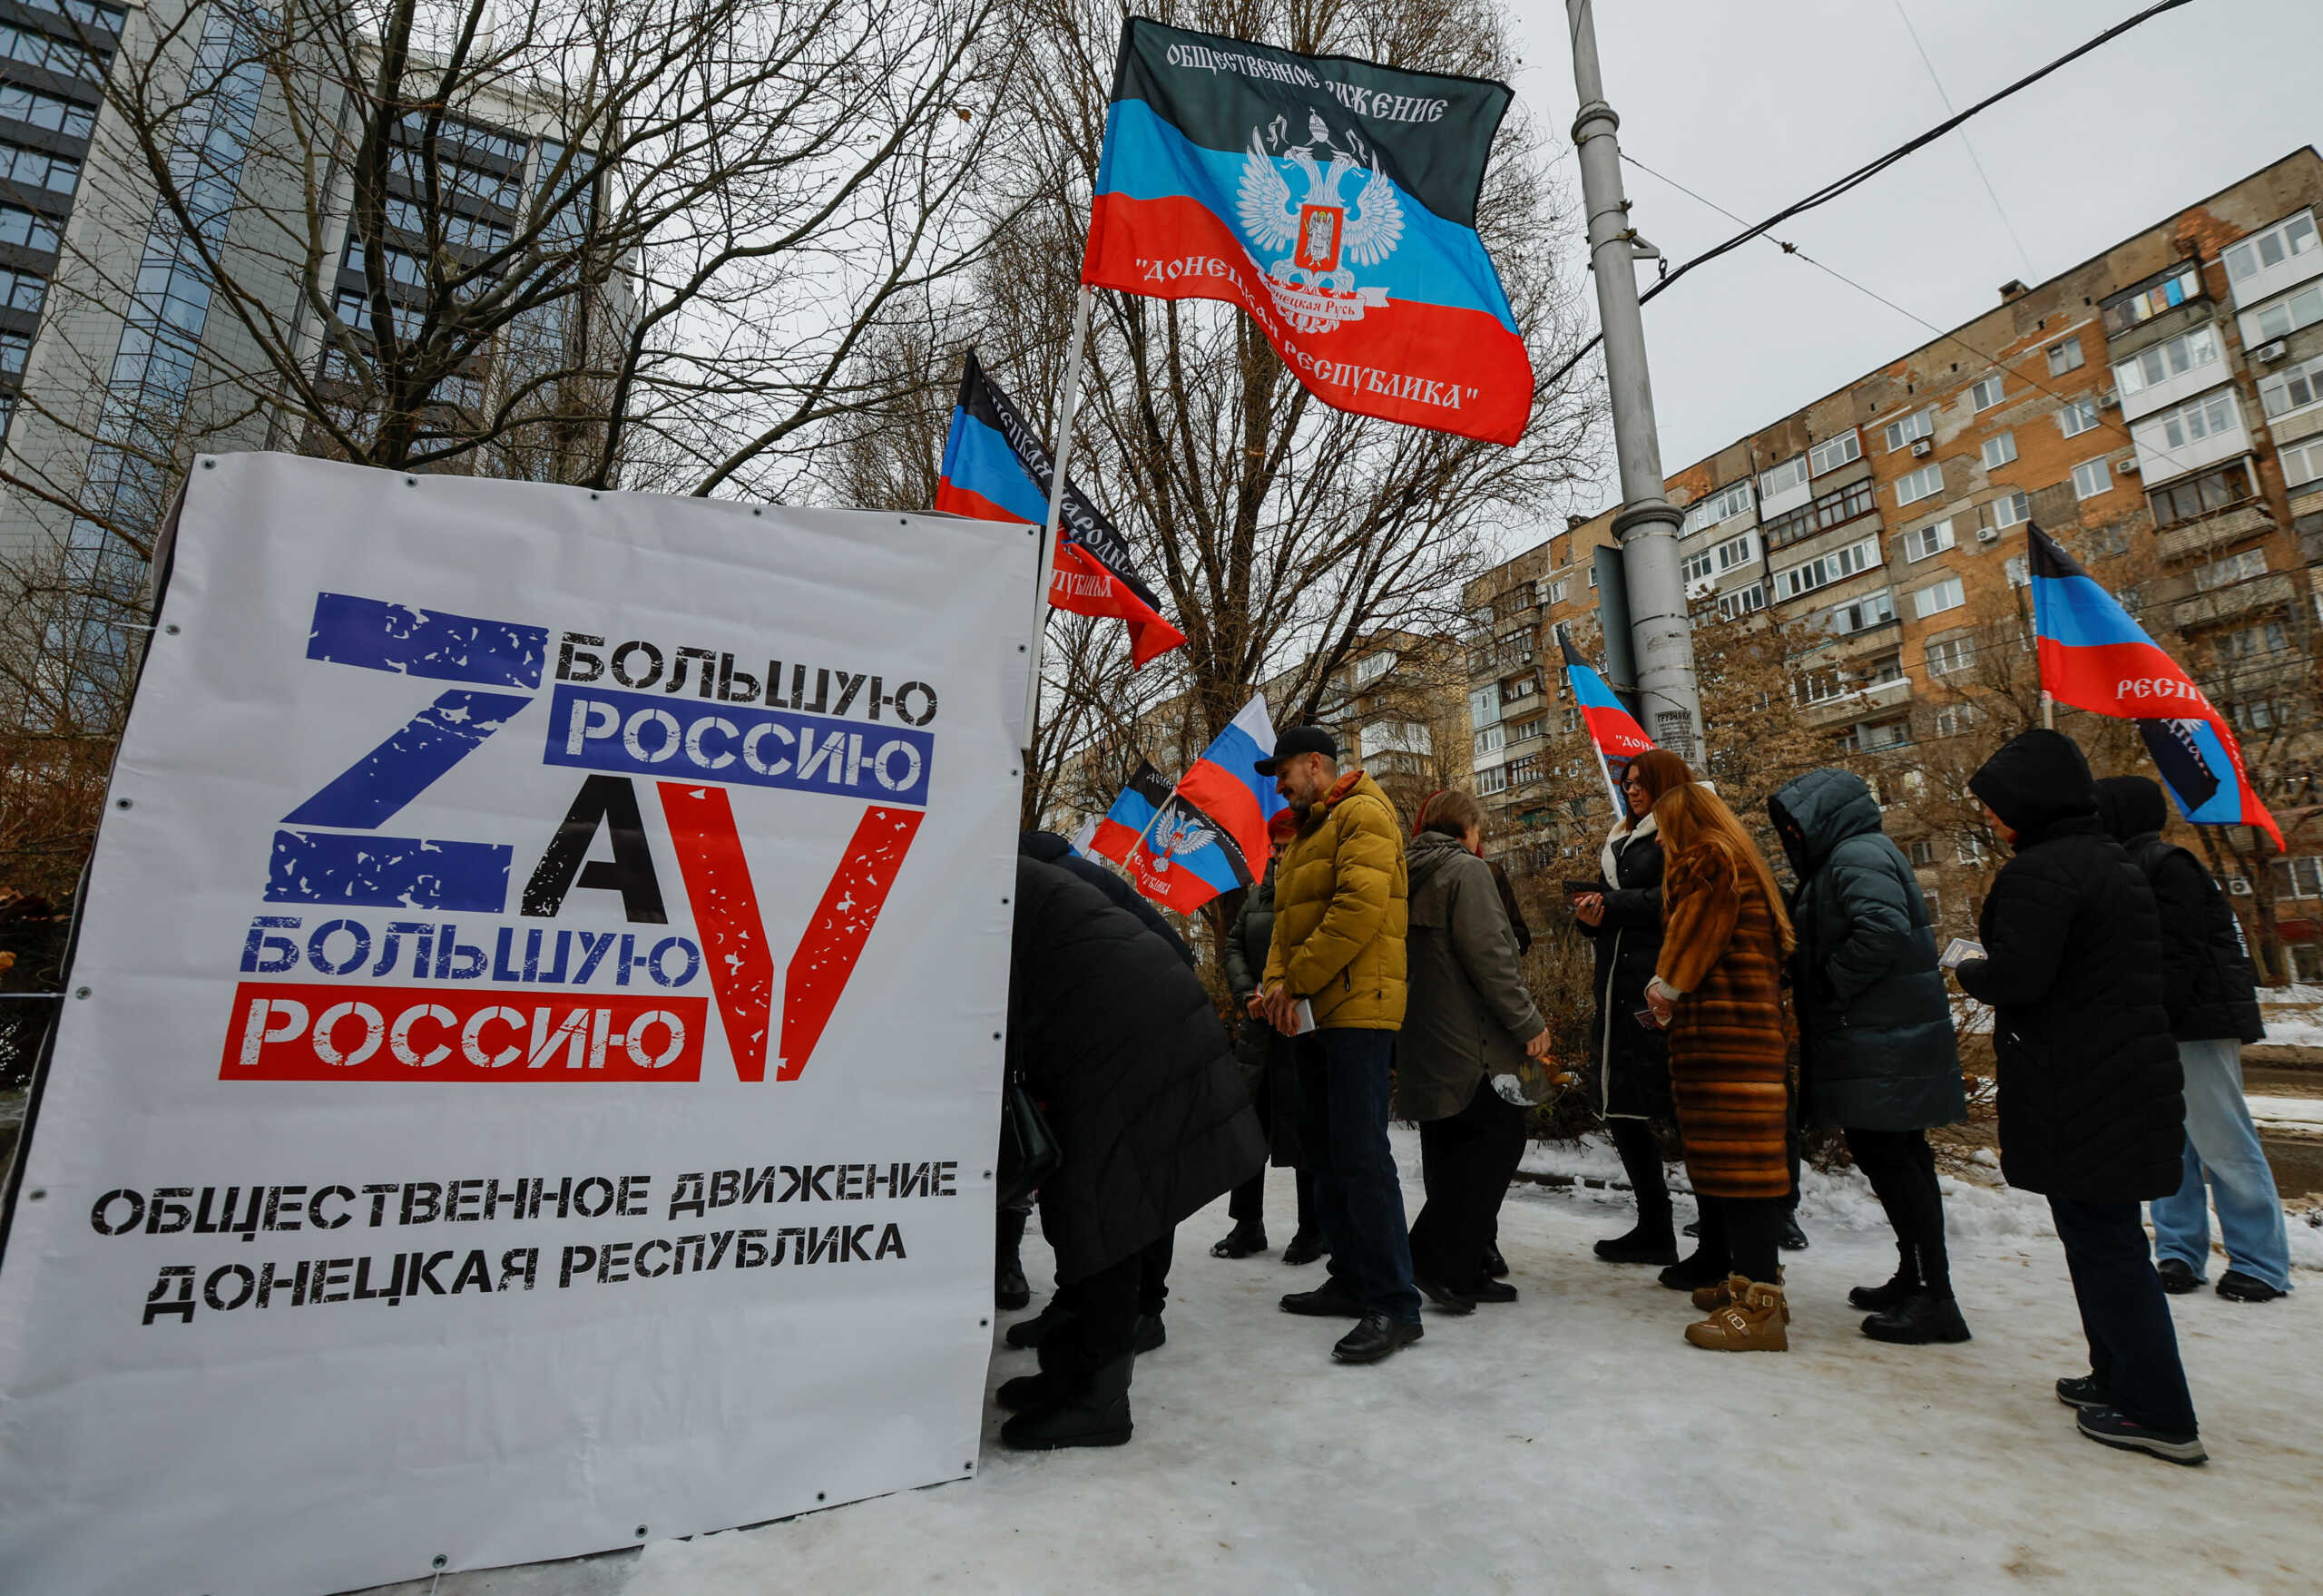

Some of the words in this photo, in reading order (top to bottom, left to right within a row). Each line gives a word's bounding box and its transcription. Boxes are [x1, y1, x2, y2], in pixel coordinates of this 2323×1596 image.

[1167, 44, 1320, 89] ОБЩЕСТВЕННОЕ
[1326, 80, 1449, 122] ИЖЕНИЕ
[1284, 339, 1479, 409] РЕСПУБЛИКА"
[555, 632, 938, 727] БОЛЬШУЮ
[564, 698, 923, 793] РОССИЮ
[240, 915, 701, 988] БОЛЬШУЮ
[240, 997, 686, 1069] РОССИЮ
[91, 1174, 651, 1243] ОБЩЕСТВЕННОЕ
[668, 1160, 958, 1216] ДВИЖЕНИЕ
[142, 1248, 536, 1326] ДОНЕЦКАЯ
[558, 1222, 907, 1288] РЕСПУБЛИКА
